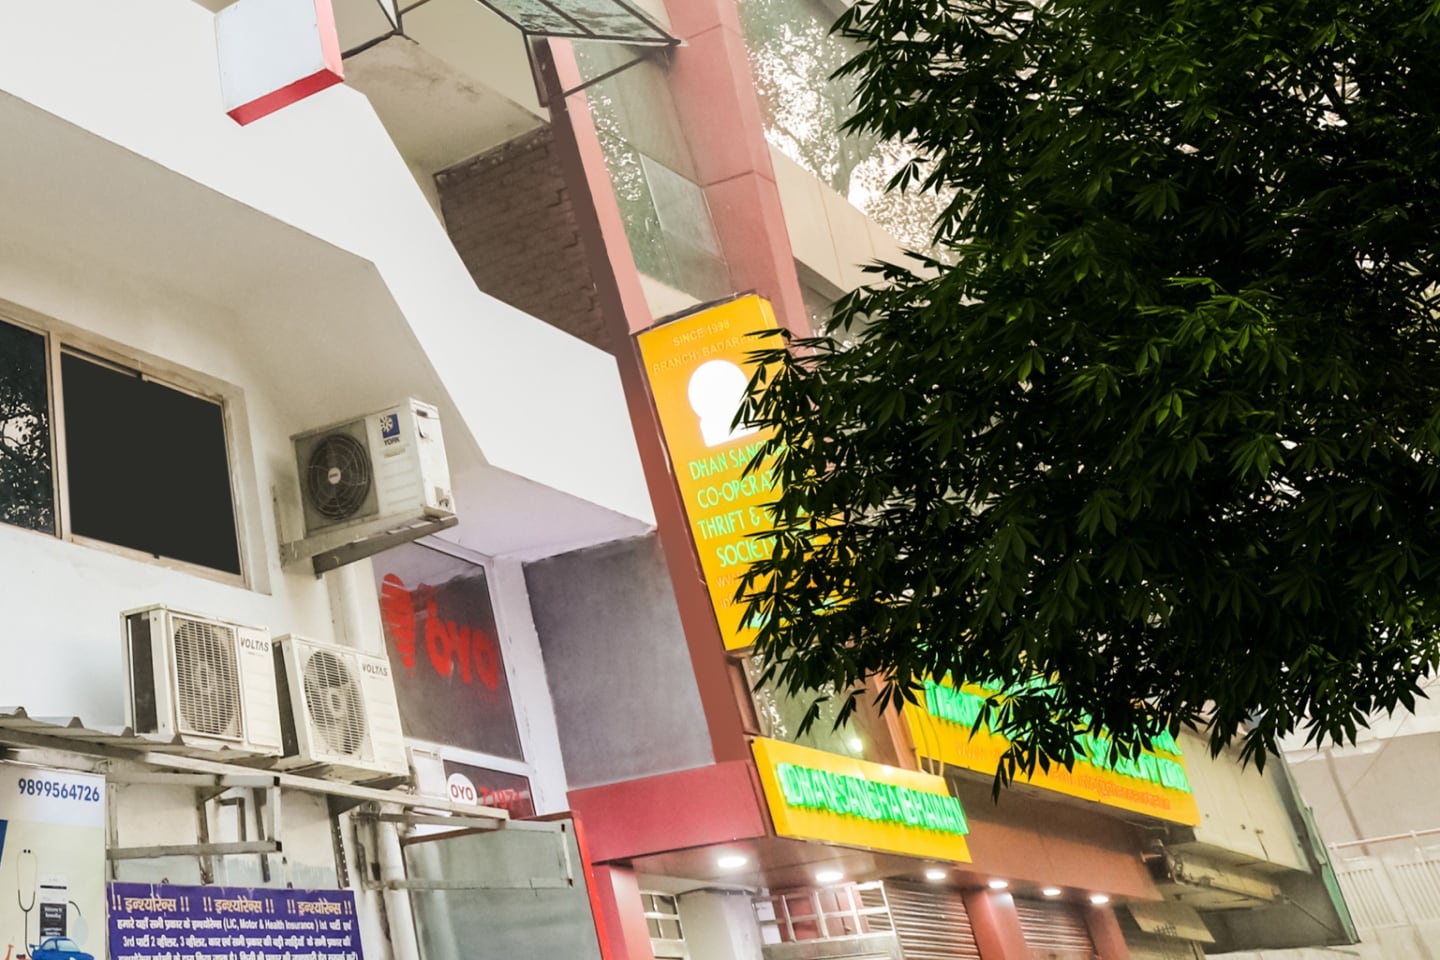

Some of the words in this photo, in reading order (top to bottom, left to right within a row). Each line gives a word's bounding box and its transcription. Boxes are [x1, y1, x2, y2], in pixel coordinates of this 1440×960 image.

[673, 328, 704, 346] SINCE
[688, 453, 729, 480] DHAN
[697, 509, 746, 540] THRIFT
[240, 637, 269, 652] VOLTAS
[362, 664, 388, 676] VOLTAS
[18, 778, 100, 803] 9899564726
[450, 783, 474, 801] OYO
